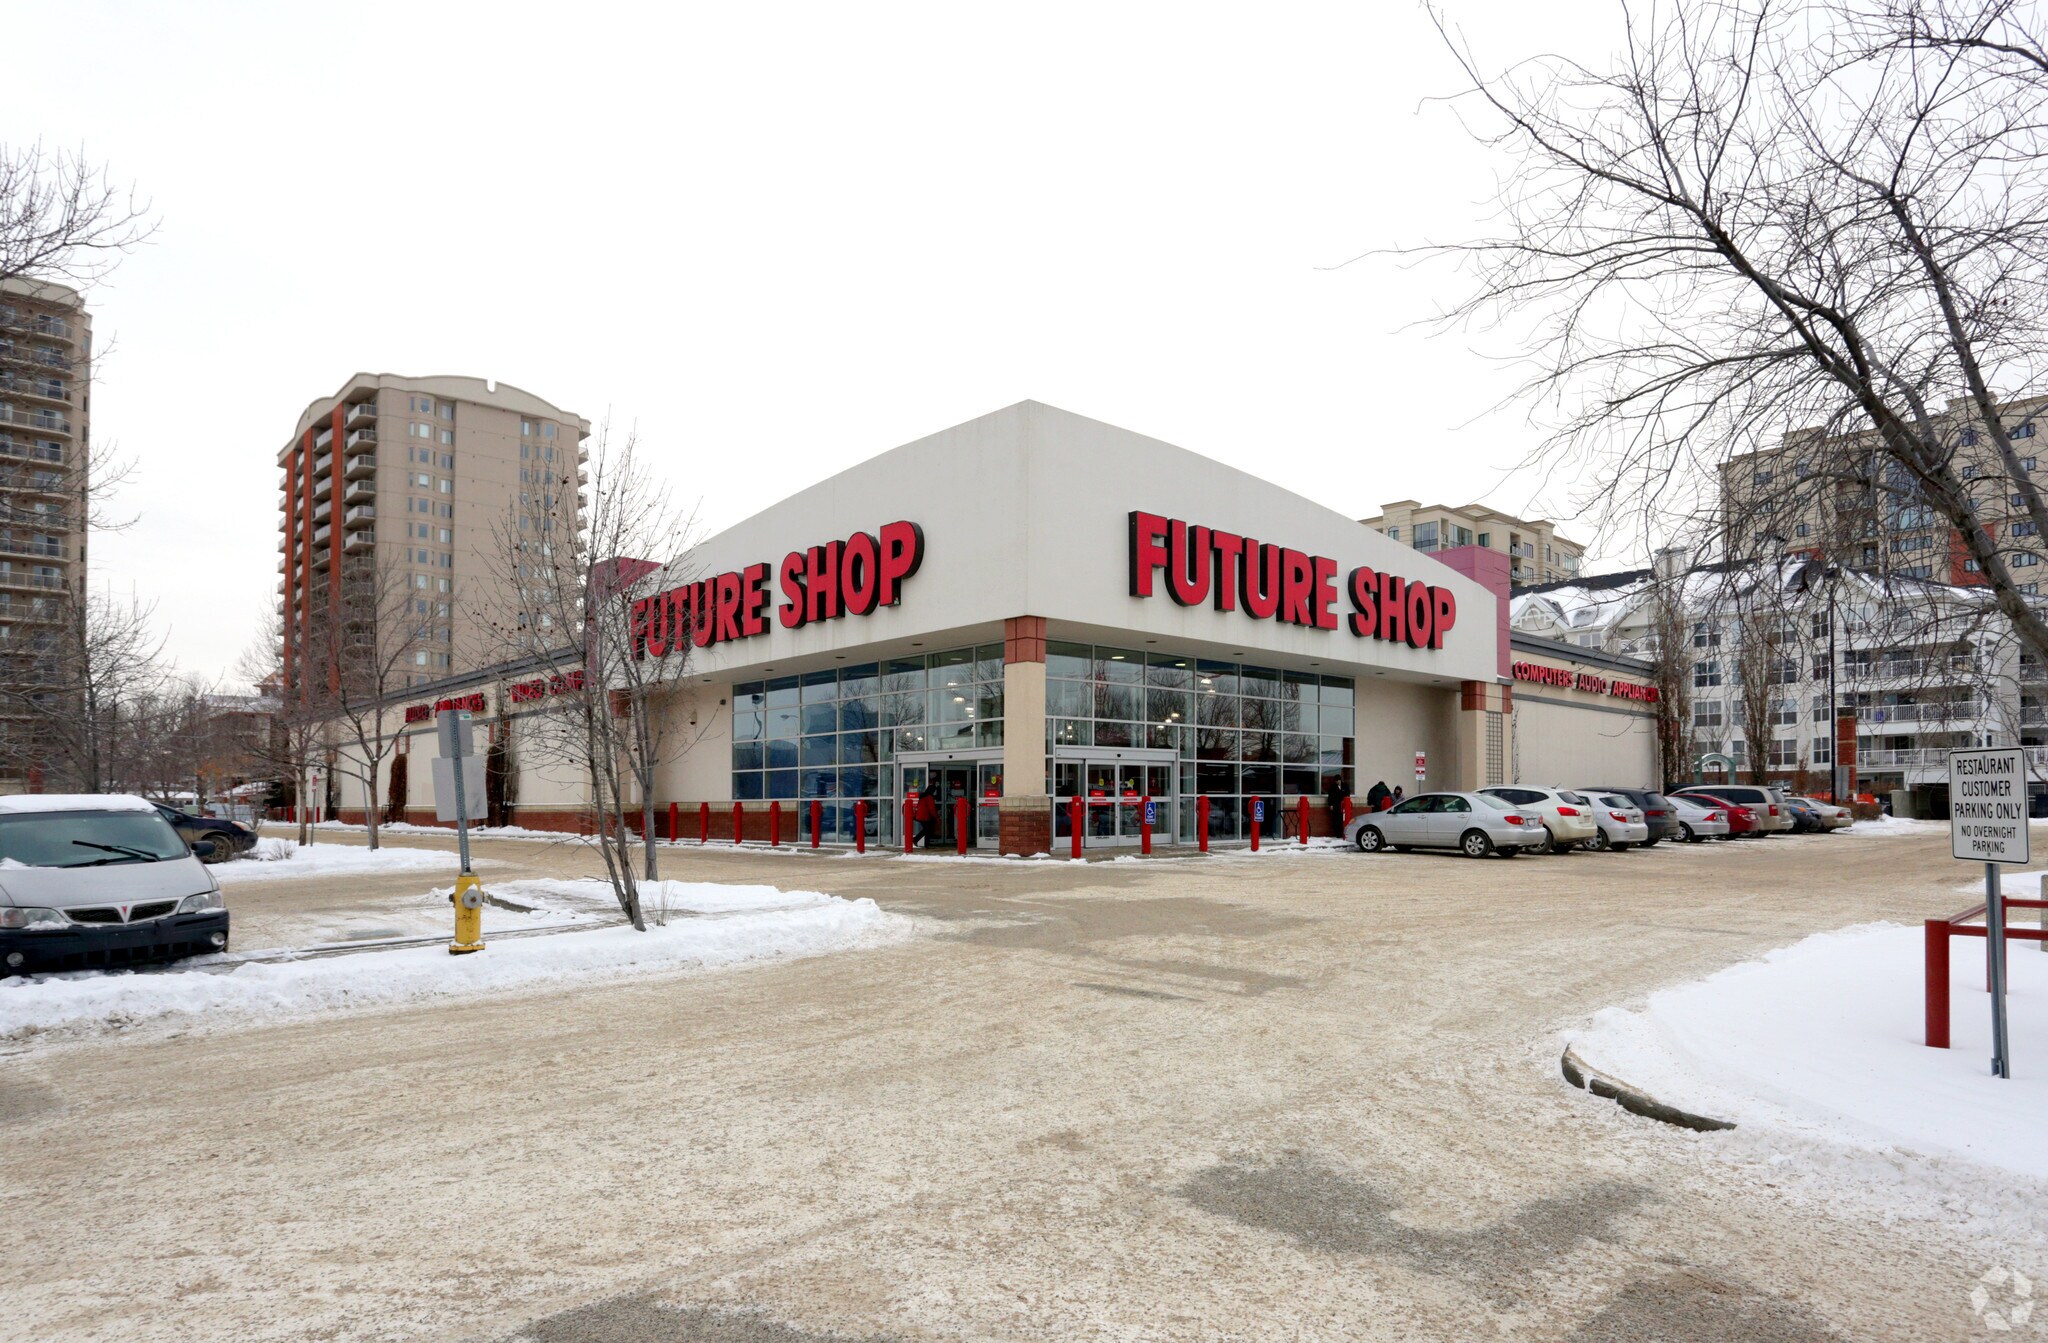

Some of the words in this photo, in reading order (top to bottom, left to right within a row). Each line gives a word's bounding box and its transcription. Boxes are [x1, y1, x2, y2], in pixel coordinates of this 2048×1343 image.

[1128, 510, 1338, 631] FUTURE
[1348, 566, 1456, 650] SHOP
[630, 562, 771, 661] FUTURE
[778, 520, 925, 629] SHOP
[1512, 660, 1574, 688] COMPUTERS
[1577, 673, 1608, 695] AUDIO
[1956, 757, 2016, 775] RESTAURANT
[1961, 780, 2012, 797] CUSTOMER
[1954, 802, 1993, 819] PARKING
[1996, 803, 2022, 820] ONLY
[1961, 825, 1972, 838] NO
[1973, 825, 2017, 839] OVERNIGHT
[1972, 840, 2005, 854] PARKING
